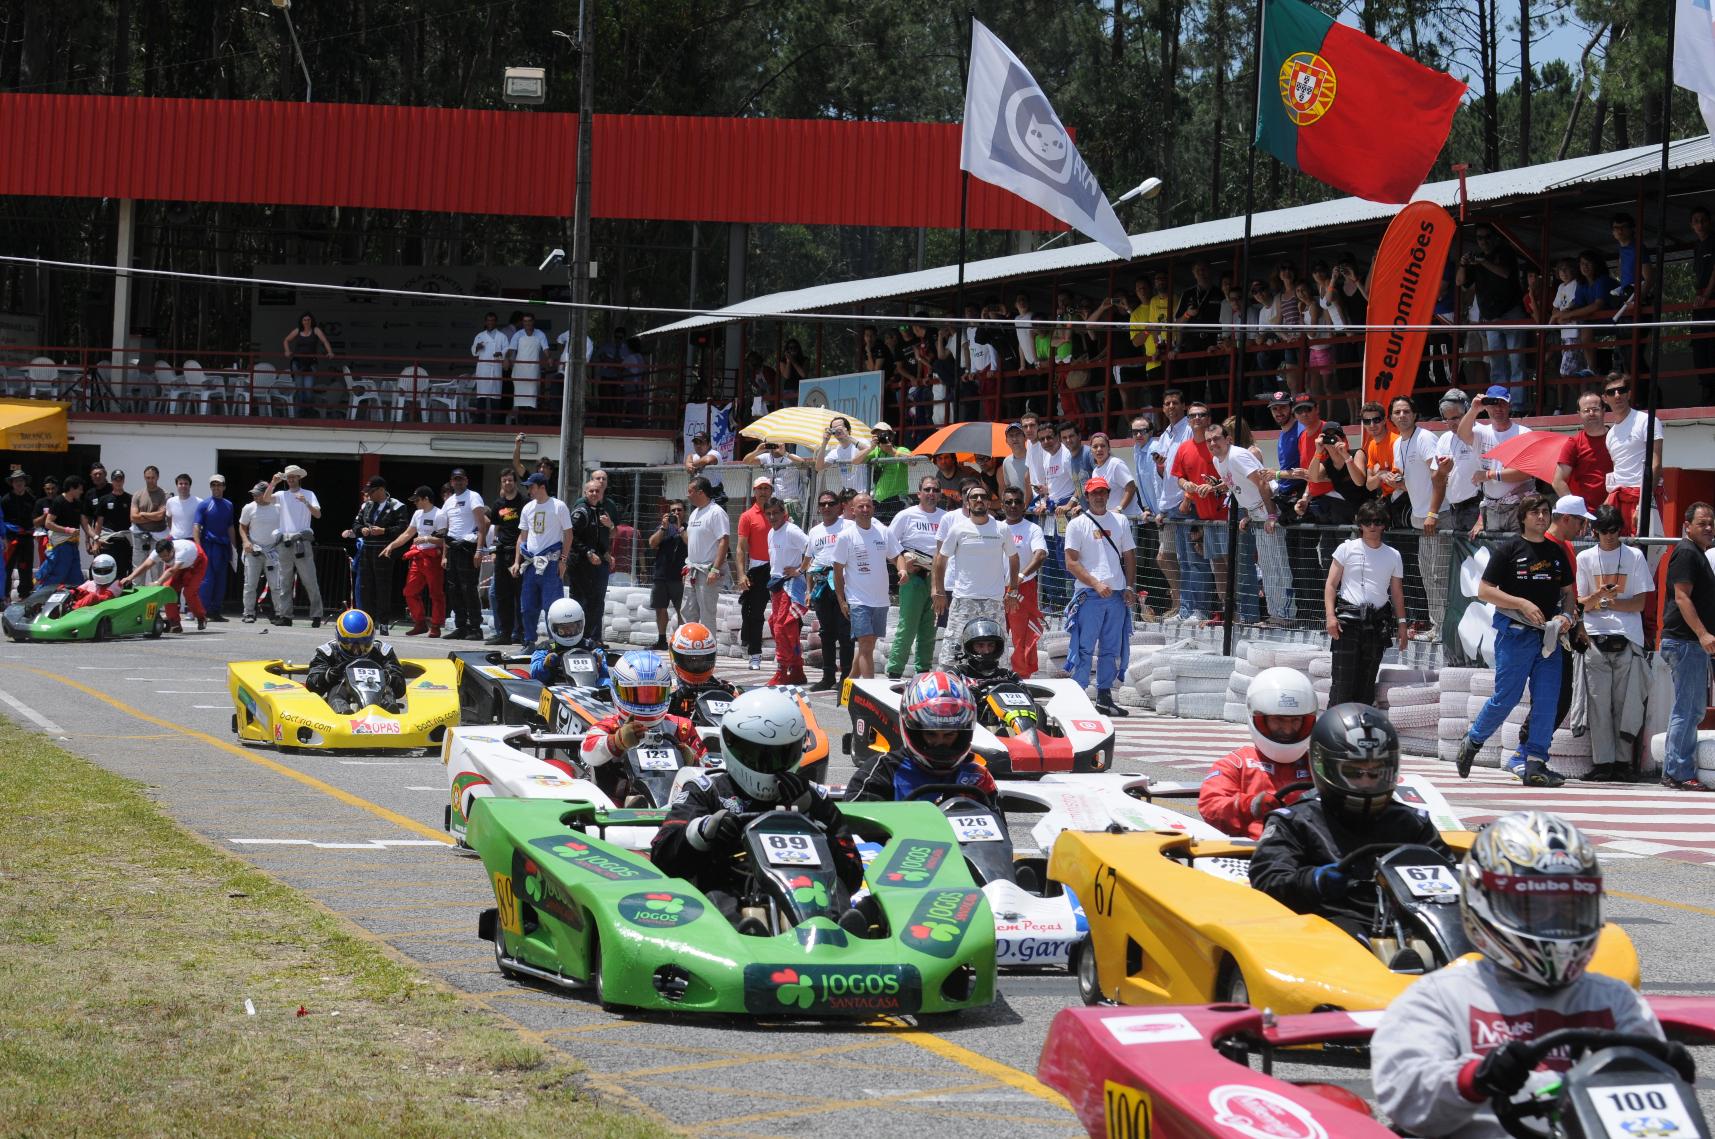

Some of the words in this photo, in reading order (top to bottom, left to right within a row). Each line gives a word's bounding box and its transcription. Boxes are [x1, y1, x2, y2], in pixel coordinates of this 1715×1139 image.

[645, 750, 669, 759] 123
[957, 817, 988, 827] 126
[768, 836, 809, 849] 89
[576, 855, 640, 877] JOGOS
[900, 846, 931, 871] JOGOS
[1406, 867, 1440, 880] 67
[1095, 863, 1116, 917] 67
[1515, 880, 1570, 891] clube
[926, 892, 964, 923] JOGOS
[634, 911, 679, 922] JOGOS
[821, 974, 900, 1002] JOGOS
[1606, 1091, 1667, 1112] 100
